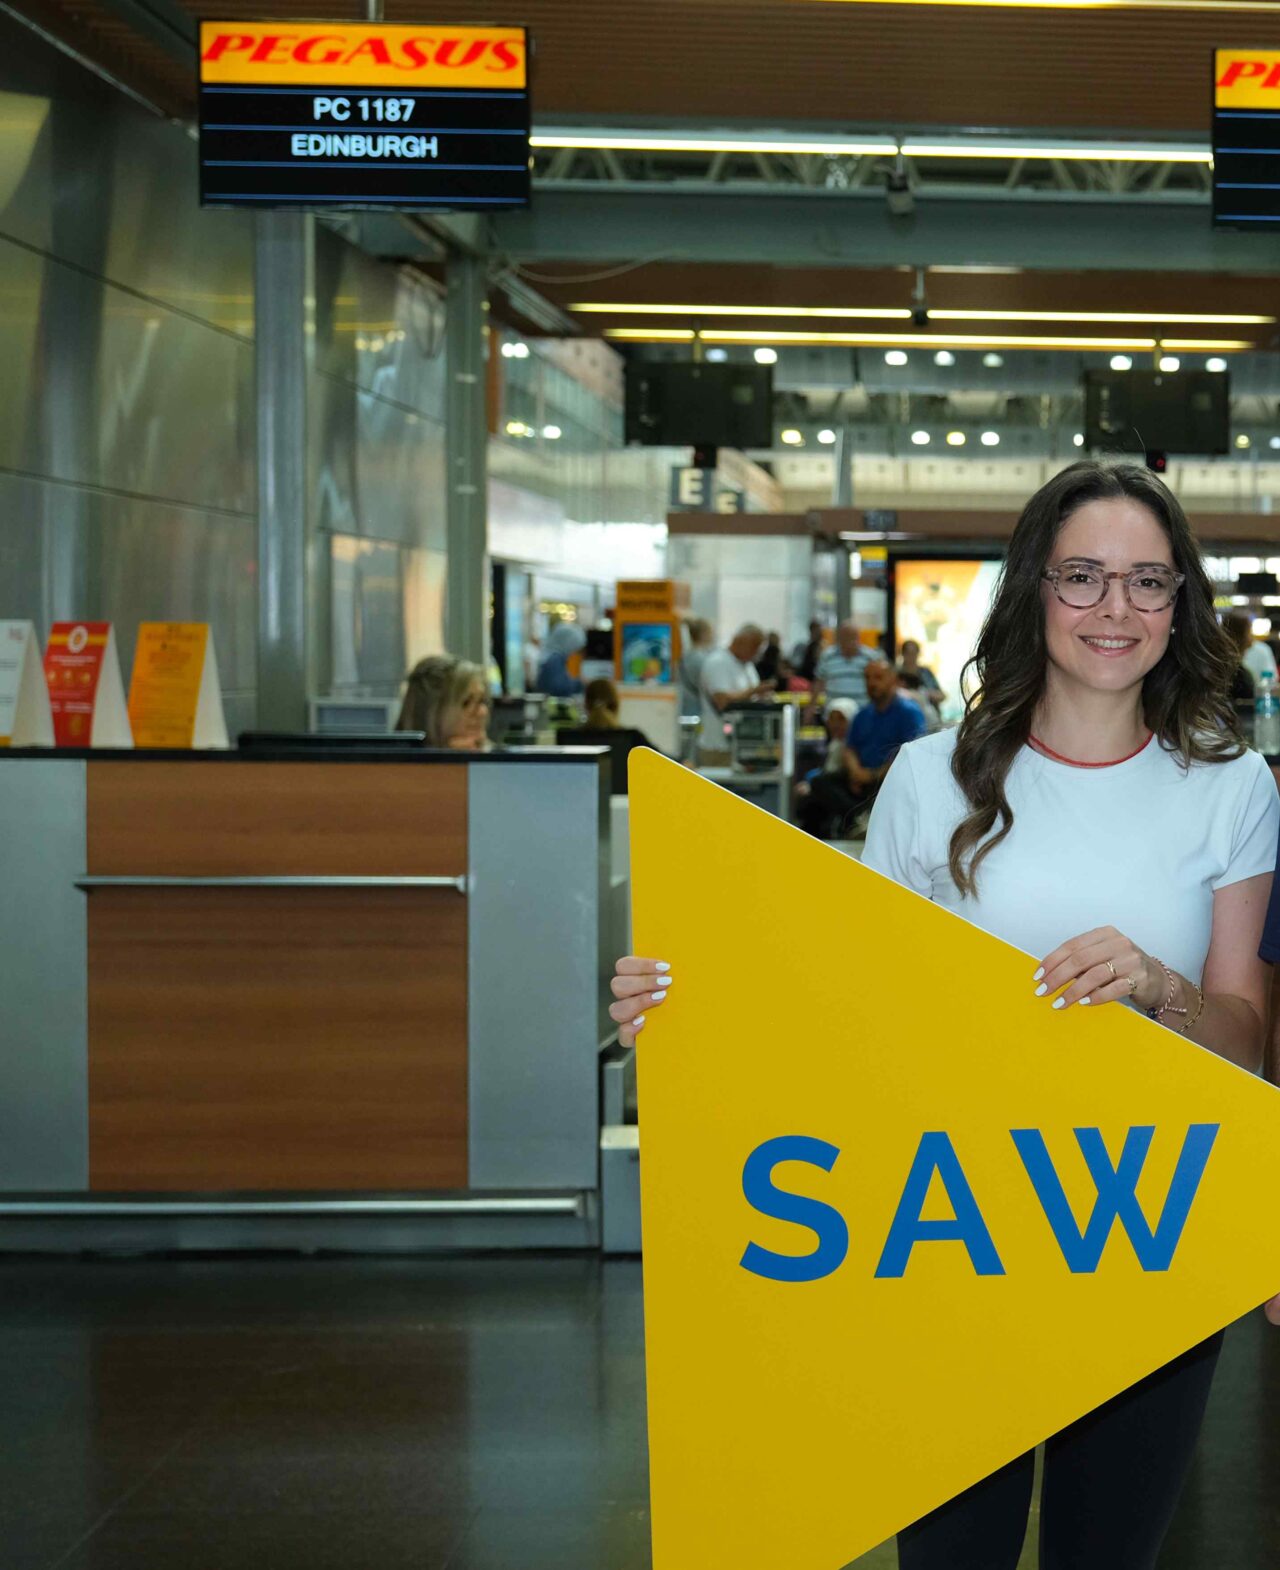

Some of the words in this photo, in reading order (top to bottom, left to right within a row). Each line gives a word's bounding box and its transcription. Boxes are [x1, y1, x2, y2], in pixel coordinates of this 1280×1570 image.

[202, 34, 525, 72] PEGASUS
[313, 97, 350, 121] PC
[357, 98, 415, 122] 1187
[291, 133, 438, 158] EDINBURGH
[679, 467, 704, 506] E
[739, 1123, 1220, 1282] SAW
